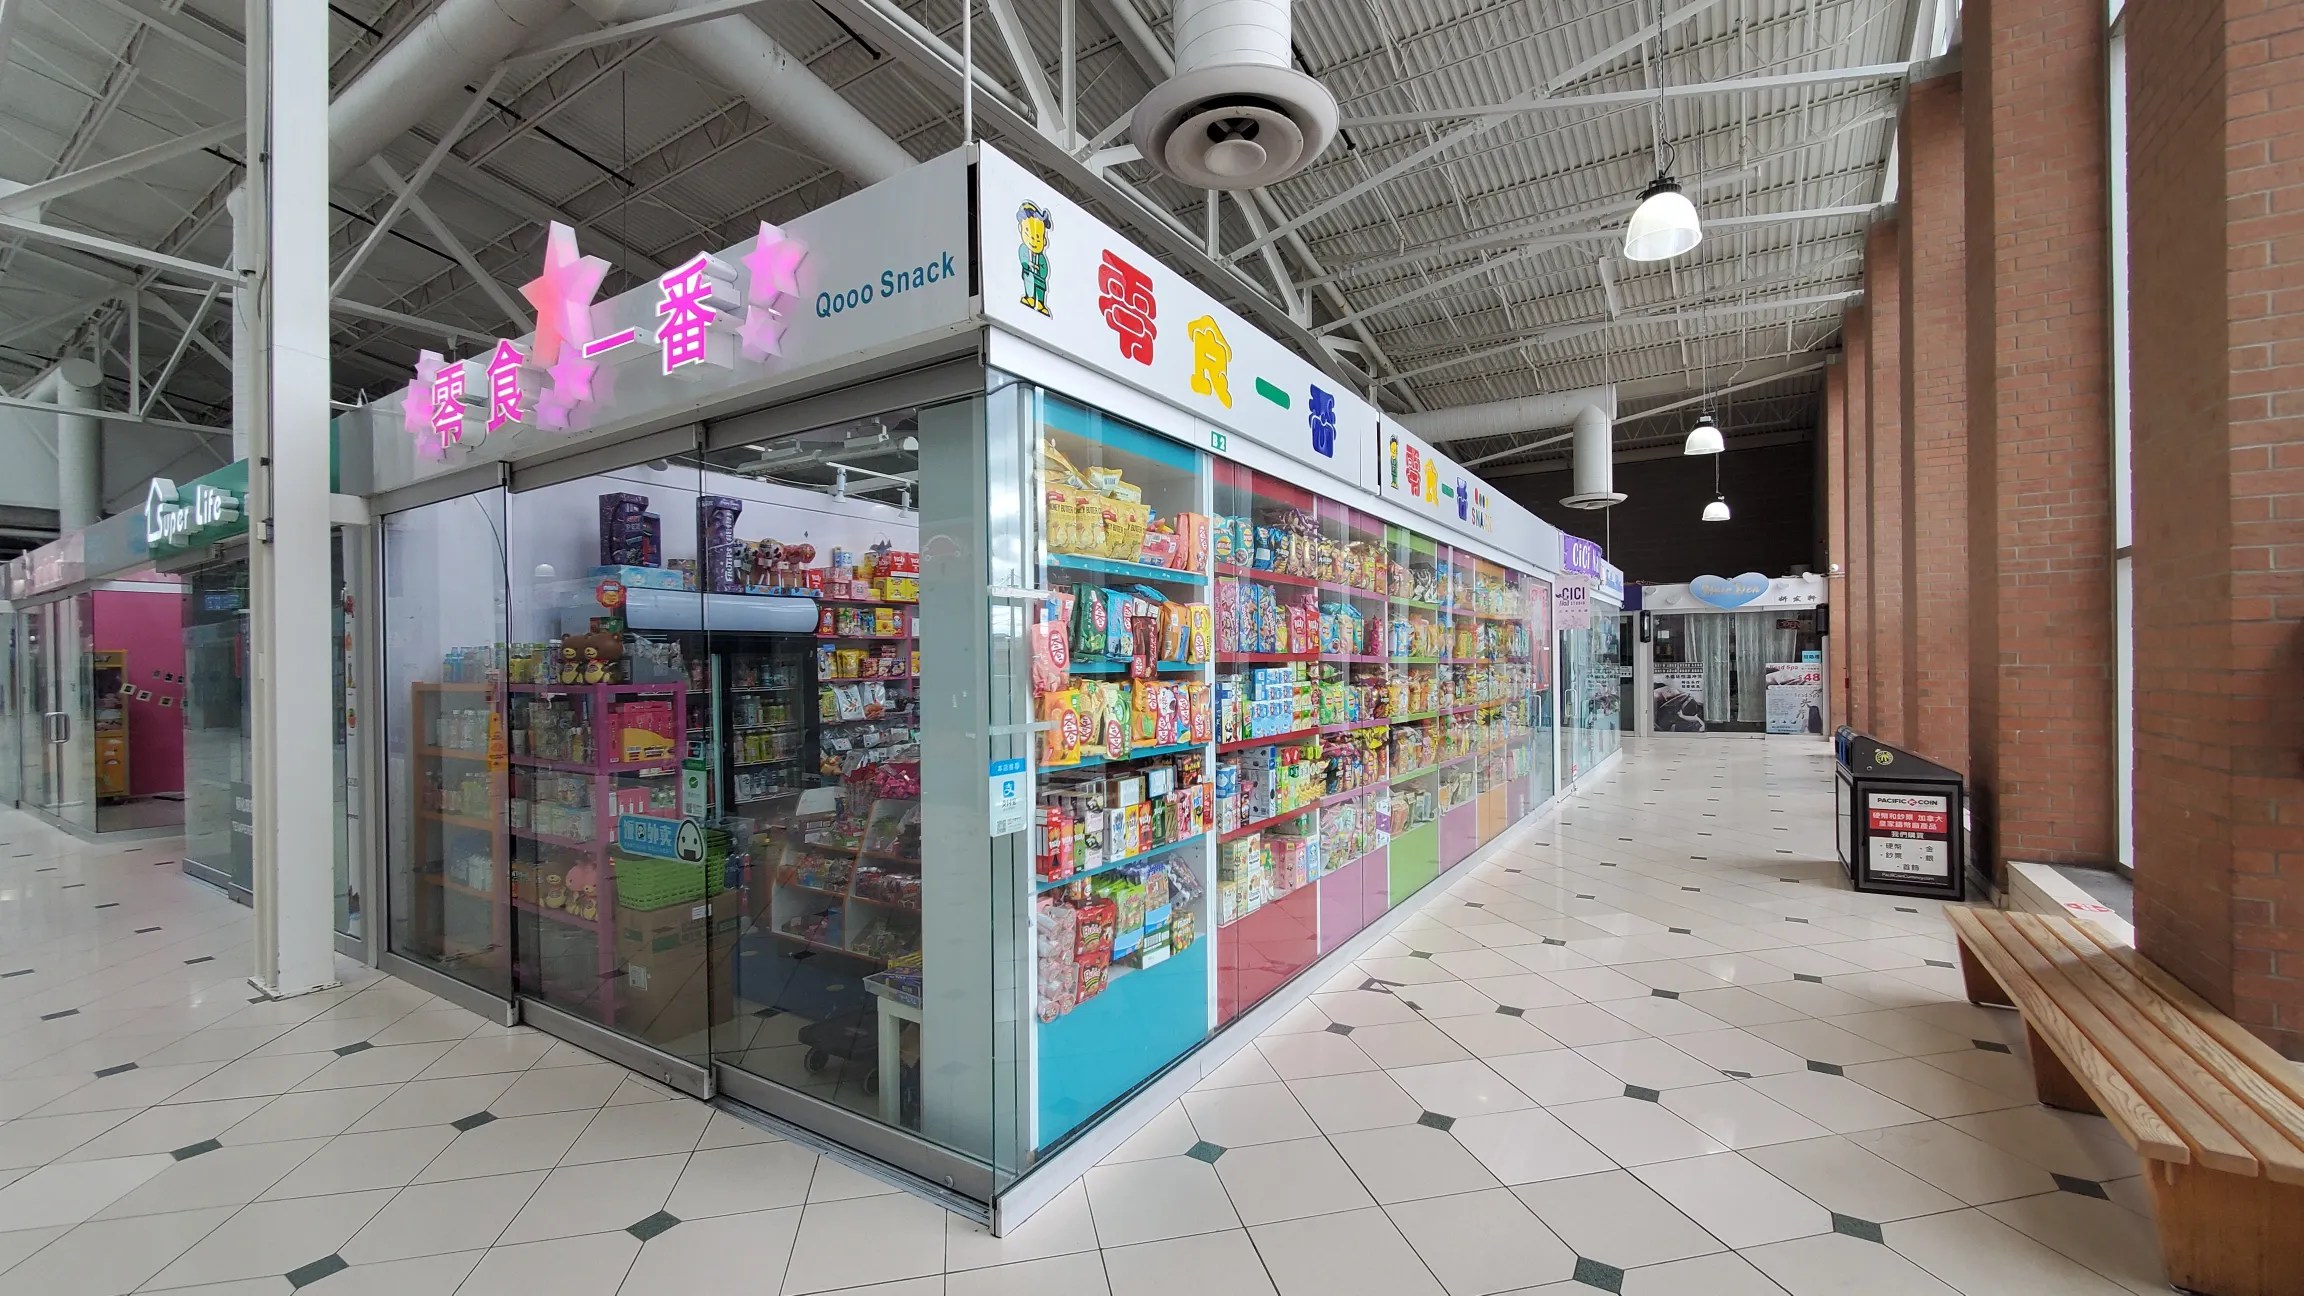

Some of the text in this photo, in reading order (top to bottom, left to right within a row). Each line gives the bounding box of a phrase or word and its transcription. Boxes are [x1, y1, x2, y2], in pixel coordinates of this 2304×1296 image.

[815, 251, 957, 319] Qooo Snack
[430, 252, 718, 449] 零食一番
[1098, 248, 1338, 460] 零食一番
[1212, 432, 1226, 451] B2
[196, 484, 222, 526] Life
[1562, 586, 1585, 601] CICI
[1877, 797, 1907, 805] PACIFIC
